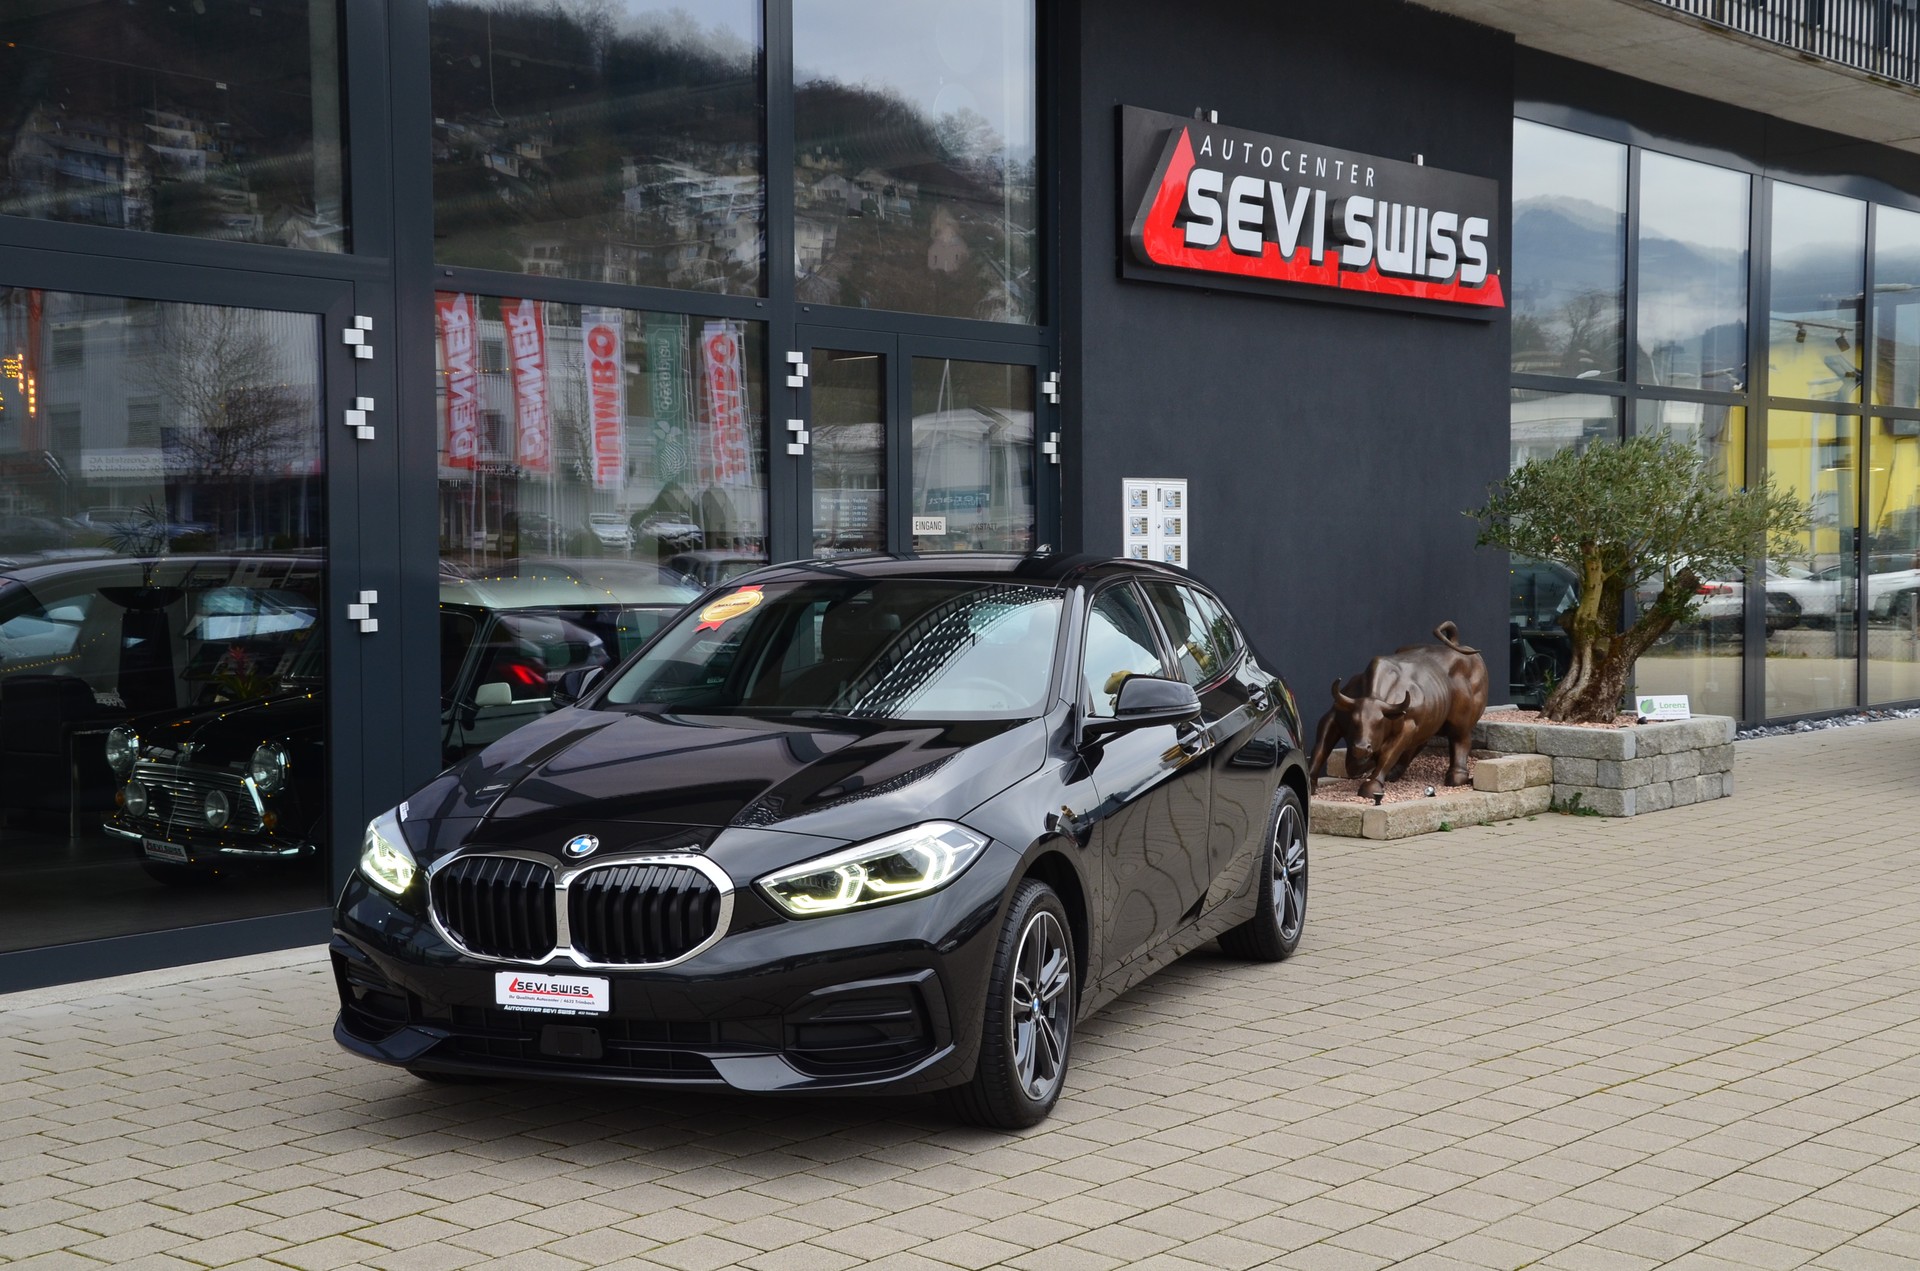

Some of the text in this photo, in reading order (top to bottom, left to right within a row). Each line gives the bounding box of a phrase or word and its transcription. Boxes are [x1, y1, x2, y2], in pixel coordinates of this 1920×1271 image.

[1200, 135, 1375, 188] AUTOCENTER
[1185, 167, 1489, 284] SEVI SWISS
[915, 520, 943, 531] EINGANG
[517, 981, 590, 995] SEVI SWISS
